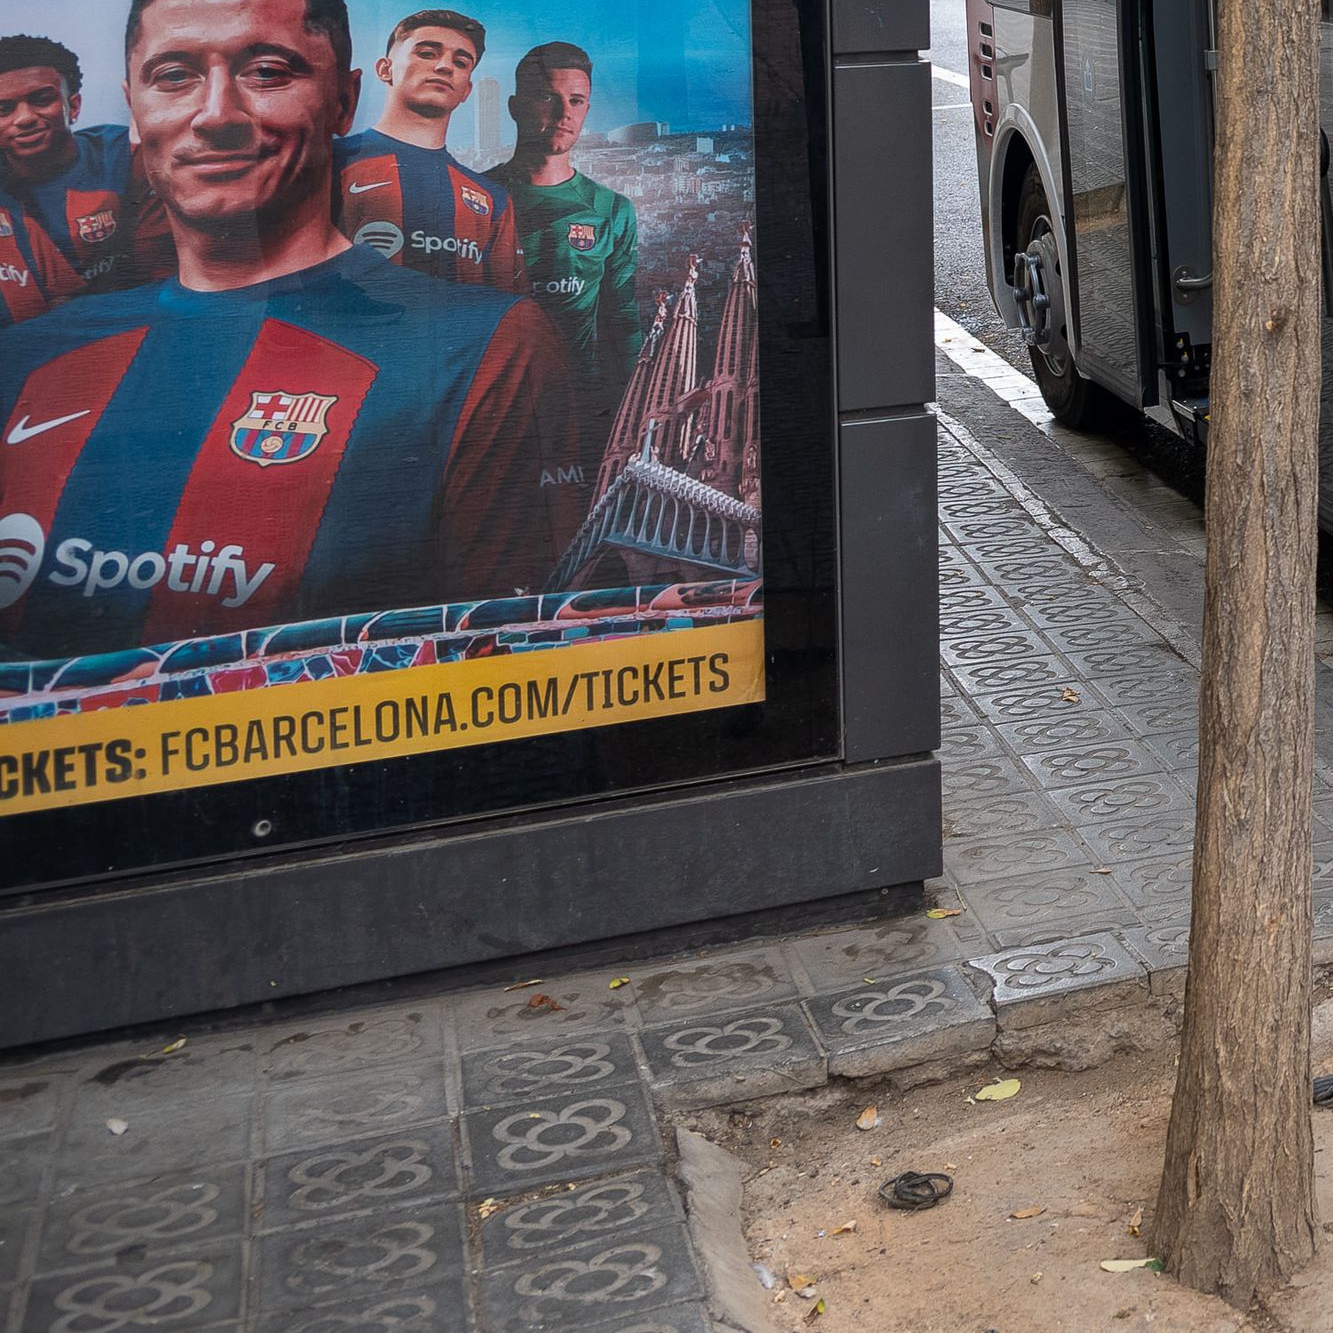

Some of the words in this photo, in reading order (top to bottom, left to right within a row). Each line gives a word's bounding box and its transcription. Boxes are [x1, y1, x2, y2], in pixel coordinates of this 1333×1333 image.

[411, 230, 483, 265] Spotify
[48, 537, 275, 608] Spotify
[161, 652, 730, 776] FCBARCELONA.COM/TICKETS
